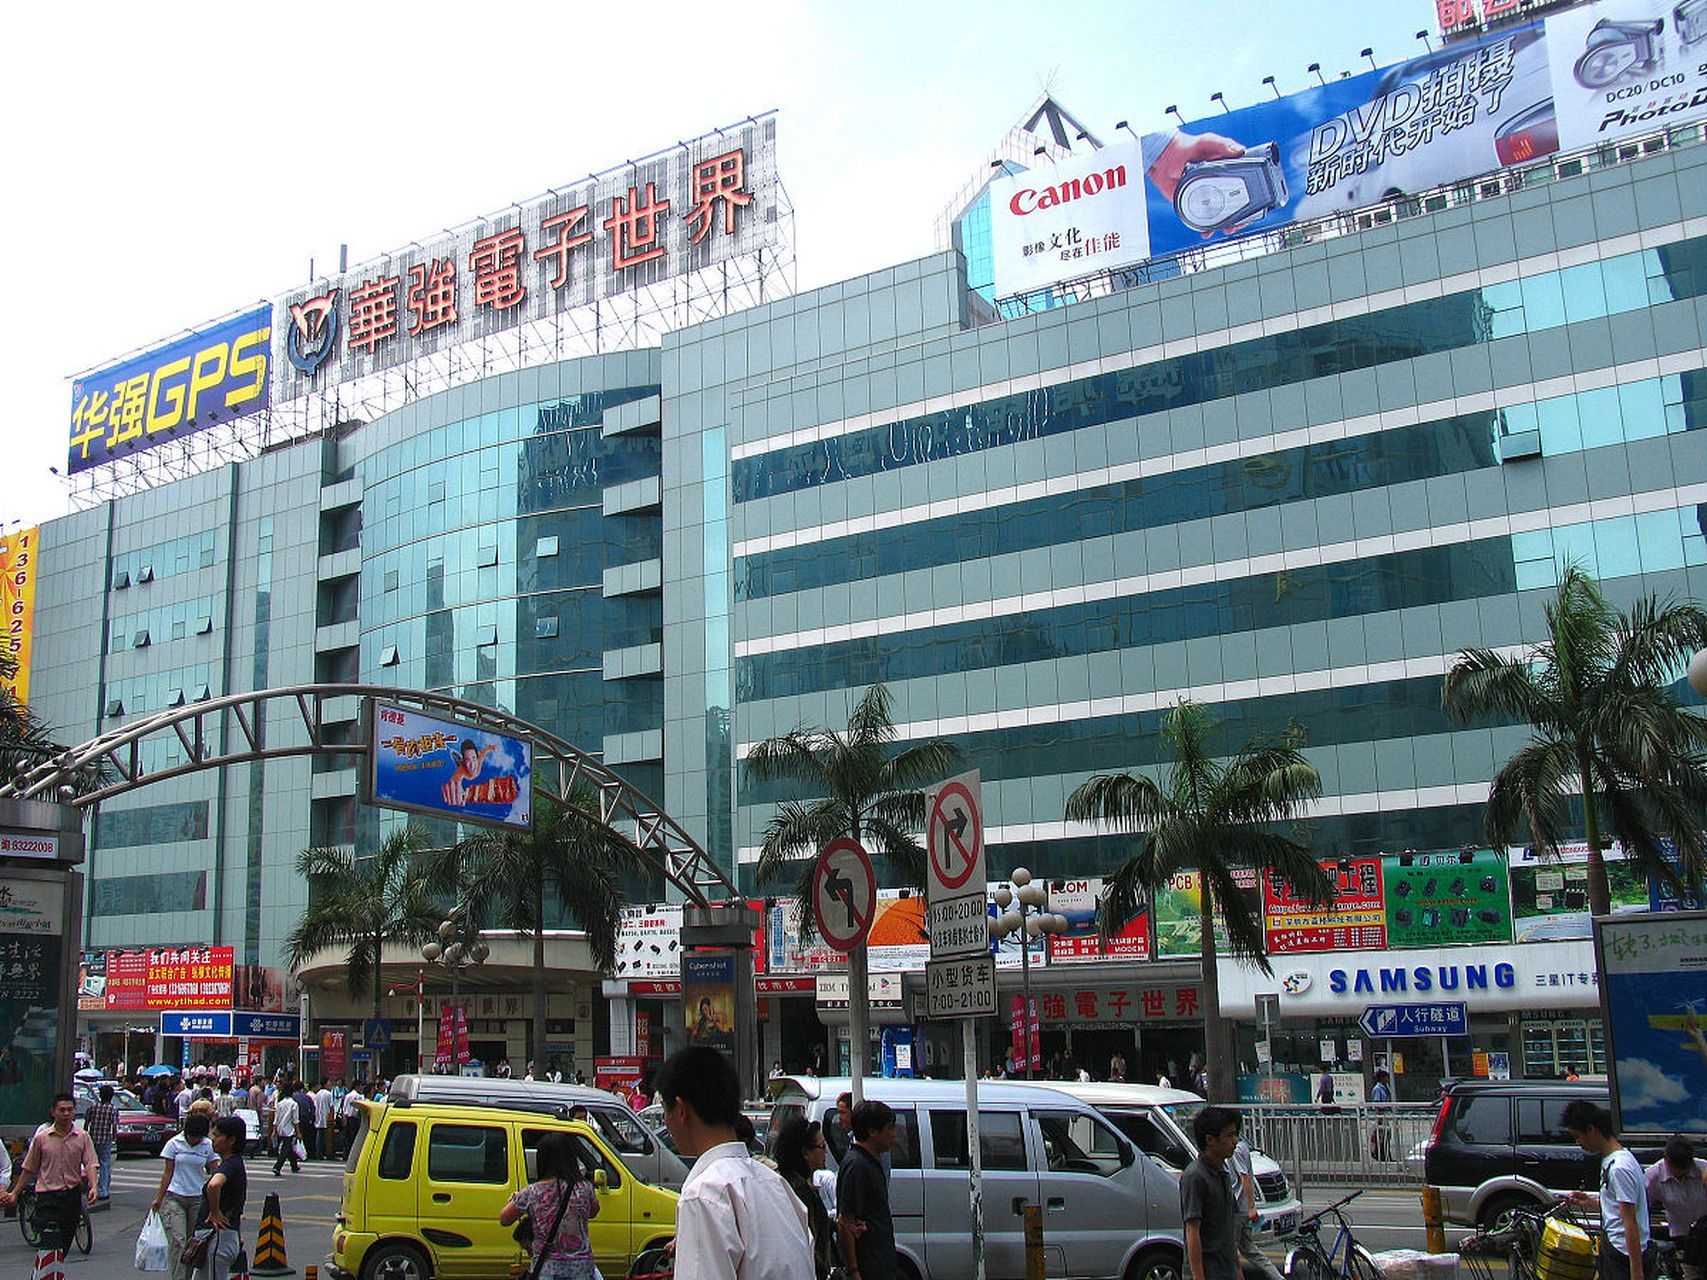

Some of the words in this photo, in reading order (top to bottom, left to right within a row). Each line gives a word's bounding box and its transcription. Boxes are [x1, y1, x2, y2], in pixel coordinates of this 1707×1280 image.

[1309, 35, 1515, 167] DVD拍摄
[1606, 73, 1685, 103] DC20/DC10
[1306, 76, 1514, 196] 新时代开始了
[1010, 165, 1127, 216] Canon
[347, 147, 754, 355] 華強電子世界
[1022, 227, 1082, 258] 影像文化
[1060, 232, 1121, 261] 尽在佳能
[70, 326, 271, 459] 华强GPS
[1168, 874, 1193, 891] PCB
[932, 964, 990, 989] 小型货车
[1329, 962, 1515, 993] SAMSUNG
[932, 990, 991, 1010] 7:00-21:00
[1400, 1007, 1461, 1024] 人行隧道
[1413, 1024, 1448, 1033] Subway
